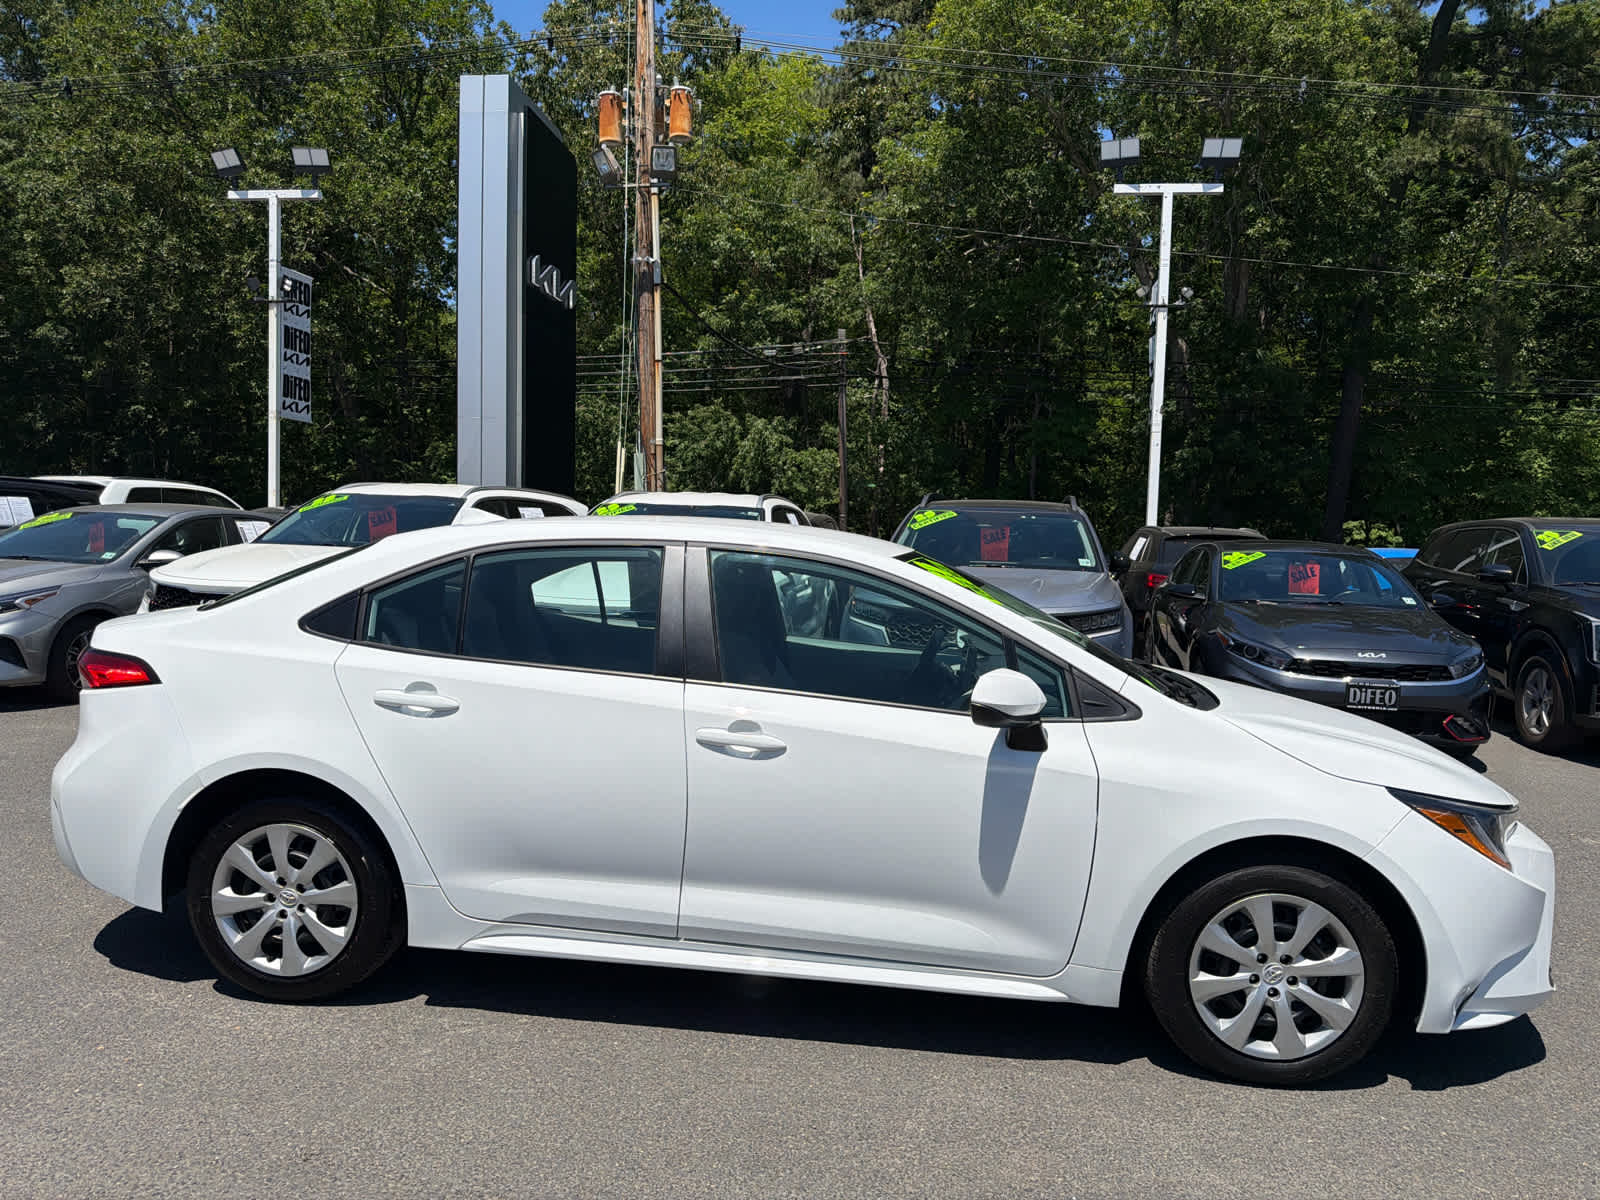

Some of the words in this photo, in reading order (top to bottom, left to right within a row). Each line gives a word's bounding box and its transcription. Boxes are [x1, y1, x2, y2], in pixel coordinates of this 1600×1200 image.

[530, 254, 576, 309] KIA
[283, 351, 310, 367] KIA
[282, 400, 310, 415] KIA
[983, 528, 1006, 543] SALE
[1291, 566, 1317, 583] SALE
[1348, 687, 1397, 706] DiFEO
